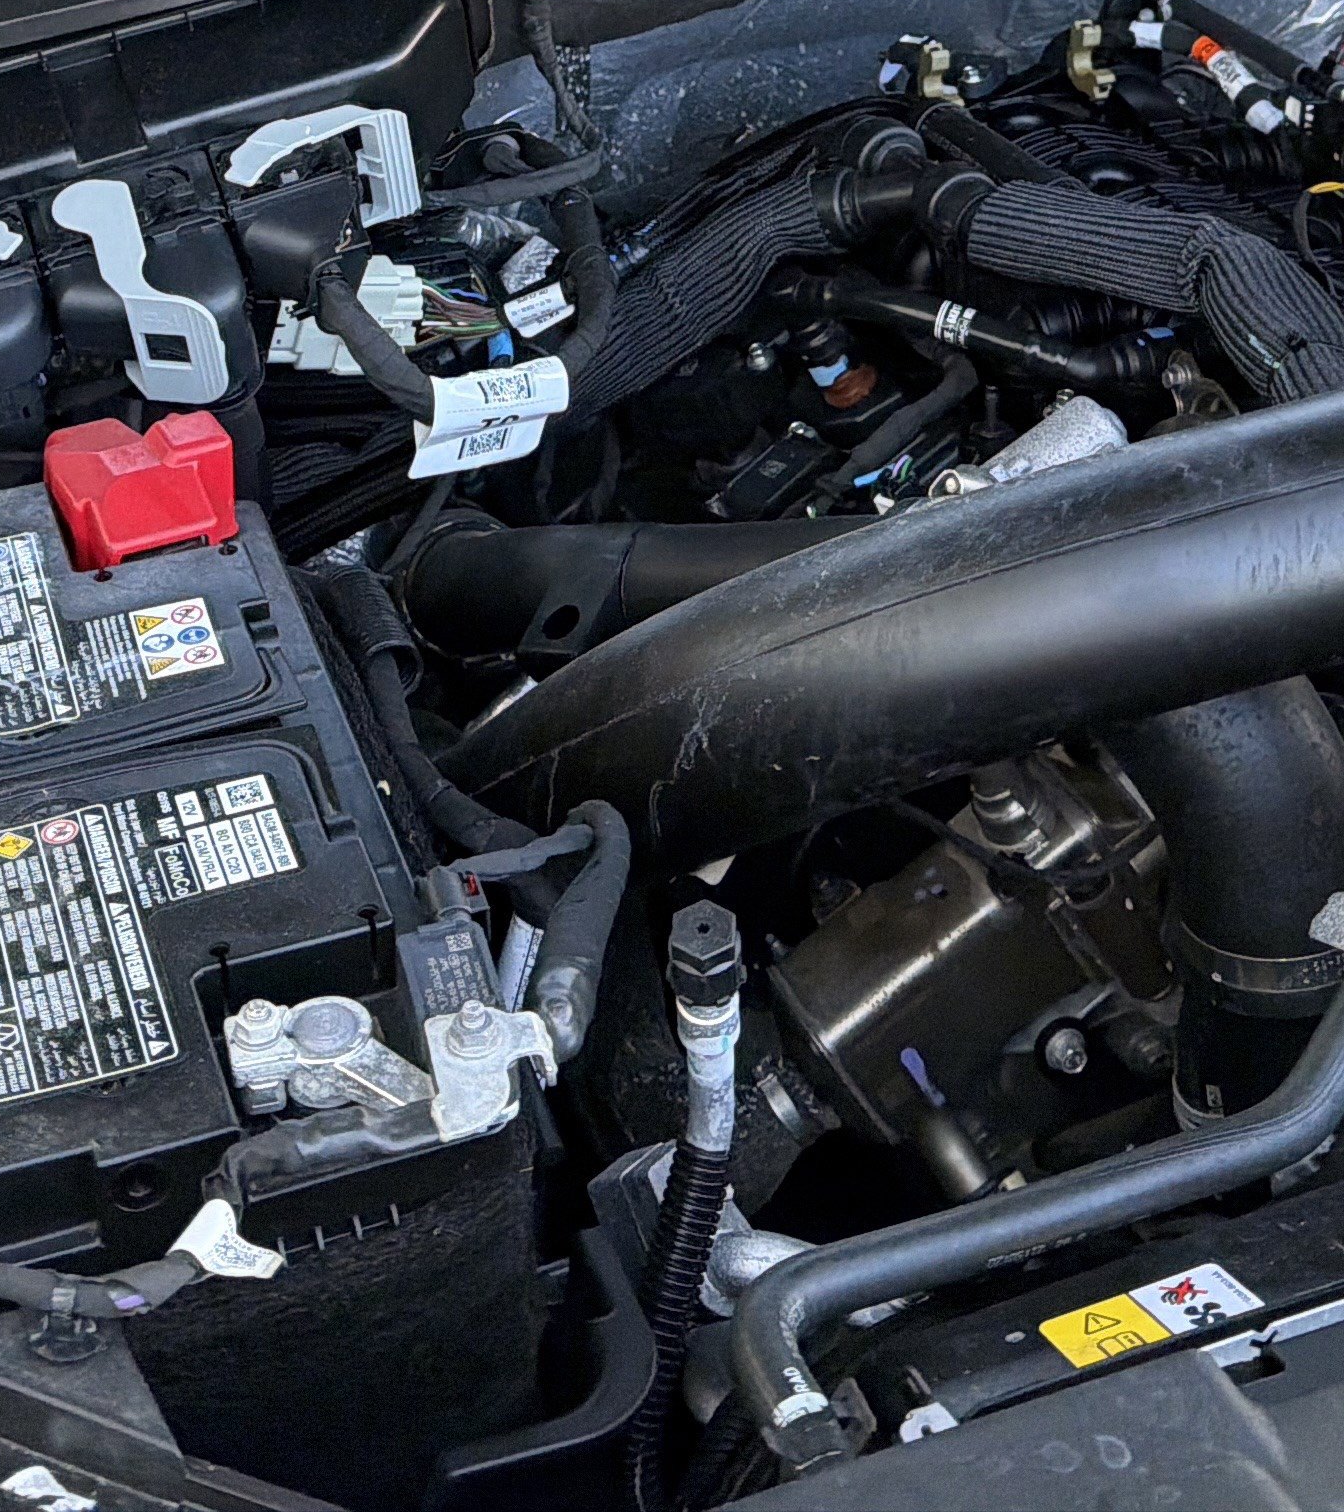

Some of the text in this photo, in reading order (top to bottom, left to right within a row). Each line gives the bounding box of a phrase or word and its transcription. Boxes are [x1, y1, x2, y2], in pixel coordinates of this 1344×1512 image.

[155, 815, 181, 841] MF
[180, 798, 198, 817] 12V
[86, 822, 122, 895] DANGER/POISON
[190, 832, 219, 885] AGM/VRLA
[214, 828, 242, 876] 80 Ah C20
[242, 833, 259, 849] CCA
[161, 846, 193, 897] FoMoCo
[111, 912, 150, 991] PELIGRO/VENENO
[782, 1366, 811, 1397] RAD
